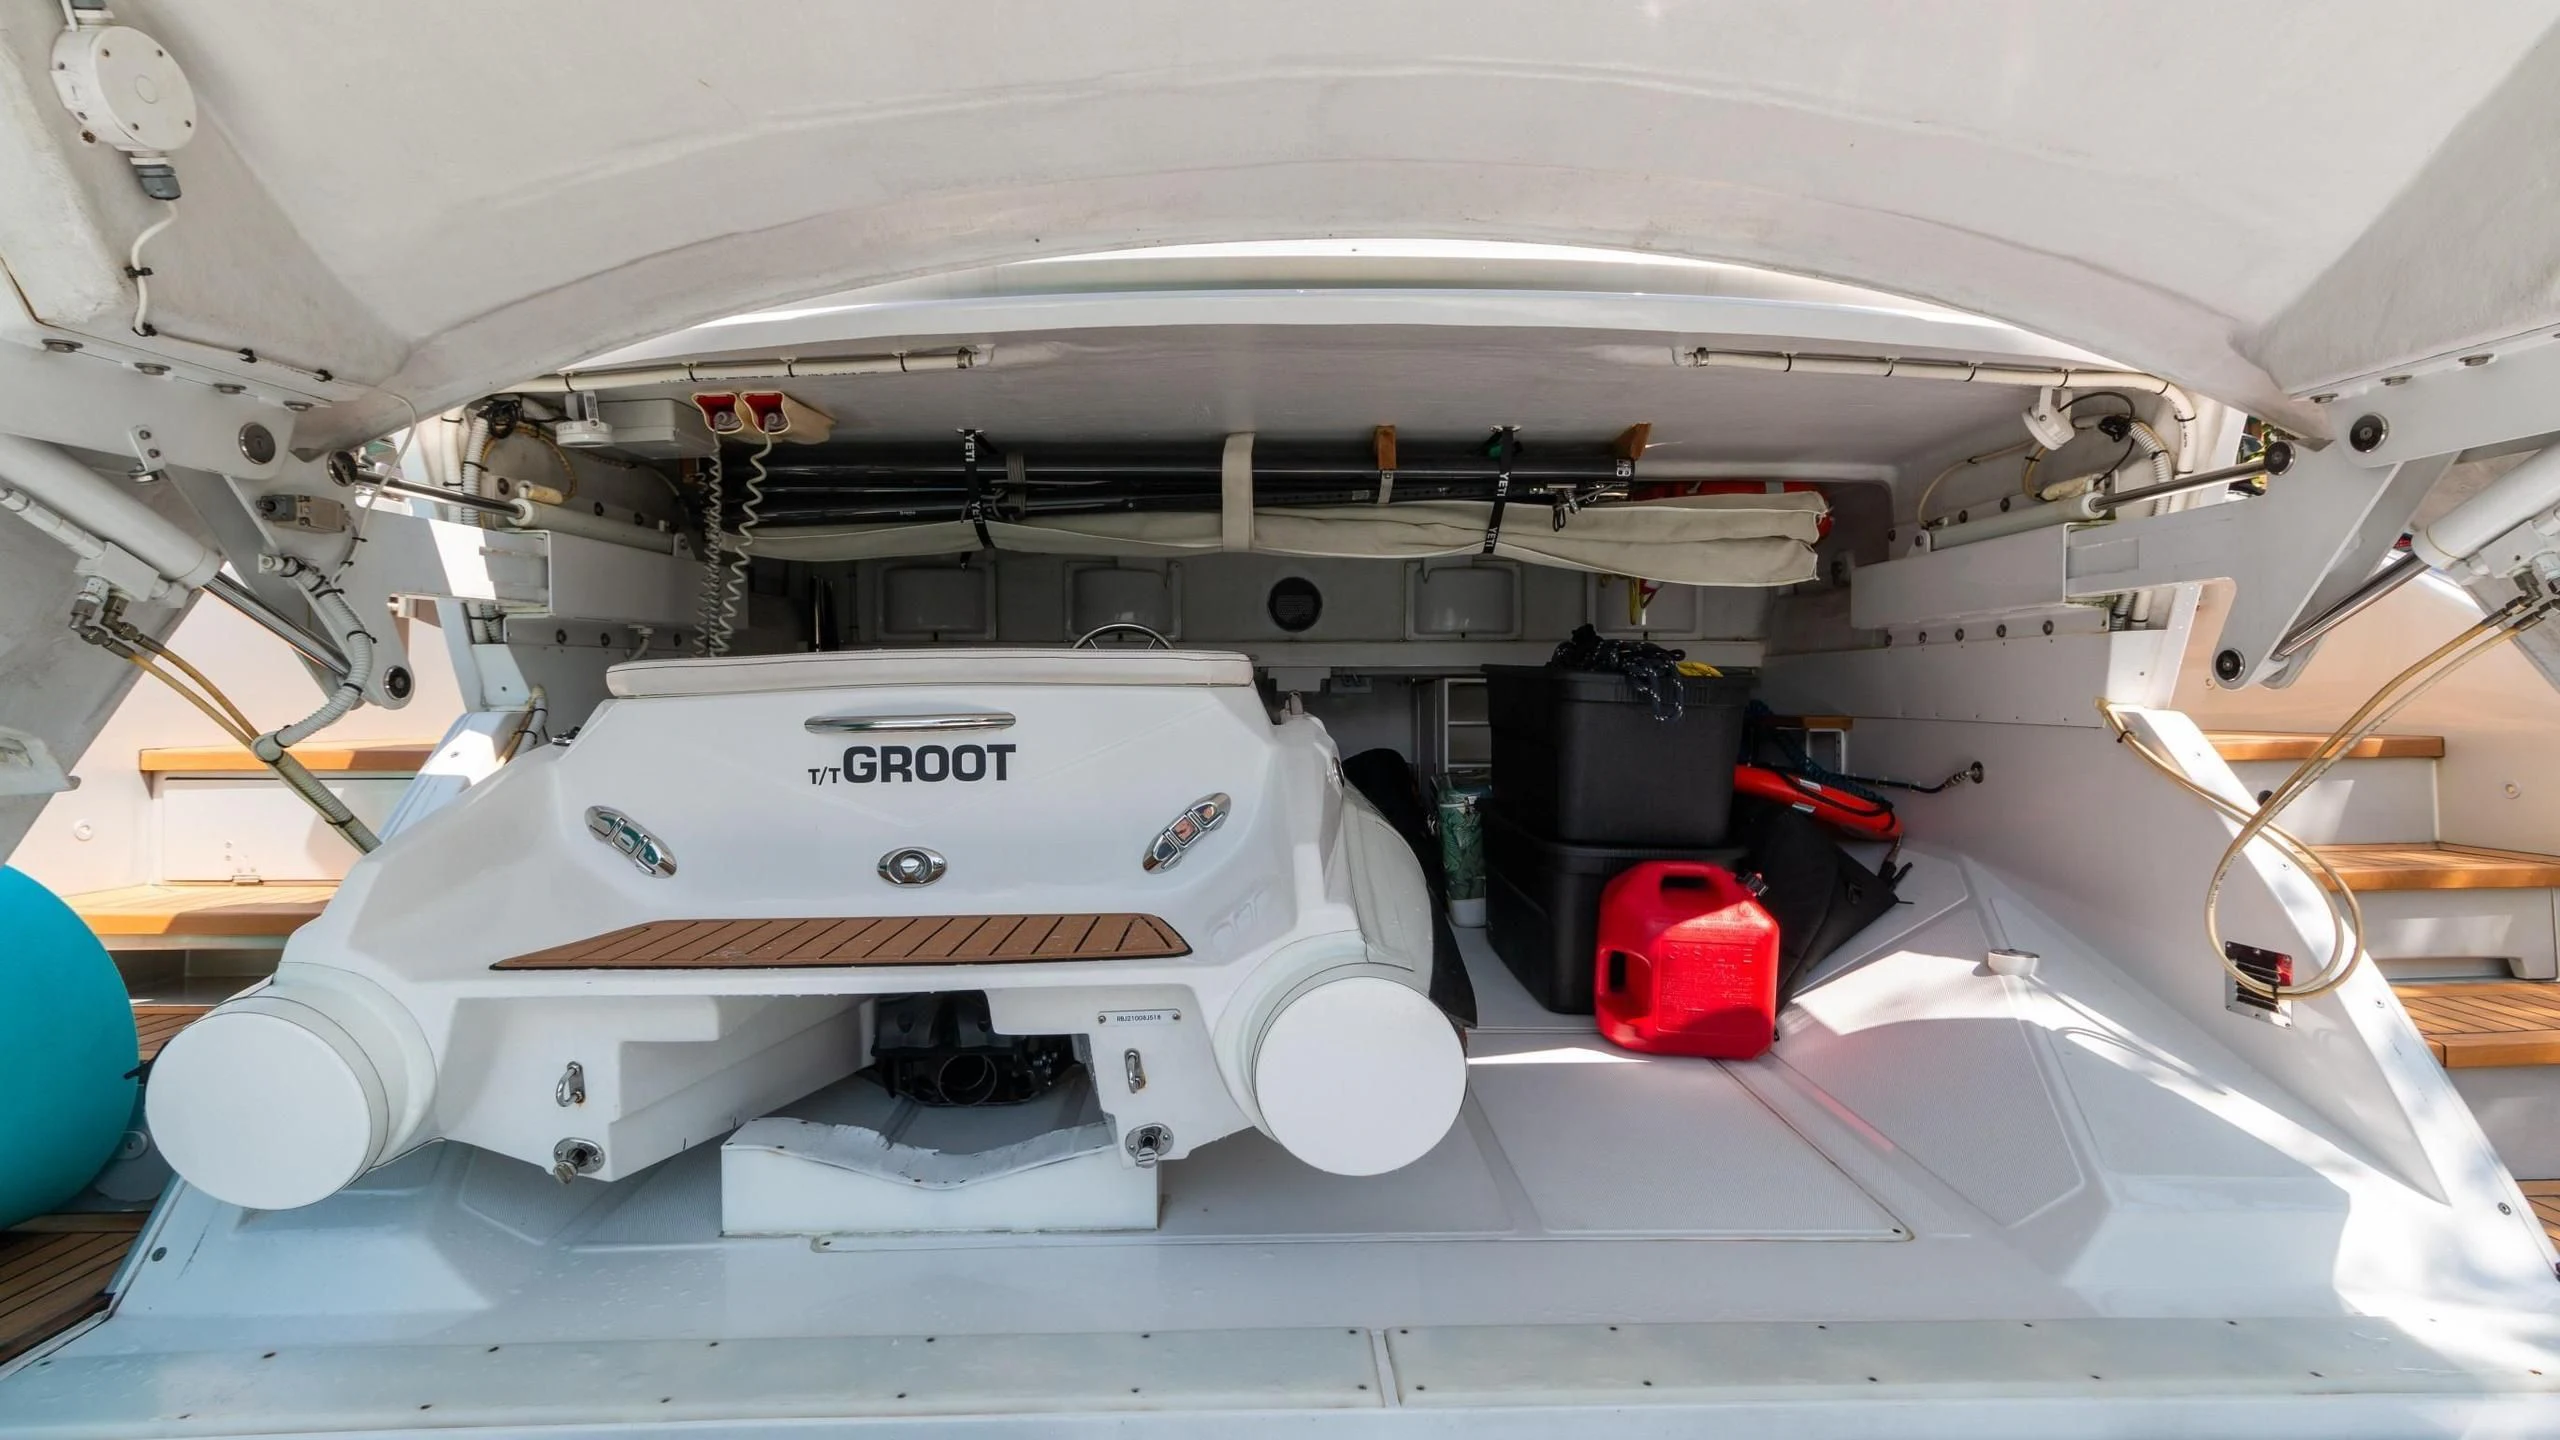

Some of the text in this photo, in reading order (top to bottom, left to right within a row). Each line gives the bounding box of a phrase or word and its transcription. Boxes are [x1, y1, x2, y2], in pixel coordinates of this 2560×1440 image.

[965, 433, 975, 462] YETI
[1497, 472, 1509, 496] YETI
[971, 501, 984, 524] YETI
[1486, 527, 1498, 547] YETI
[807, 744, 1016, 786] T/T GROOT
